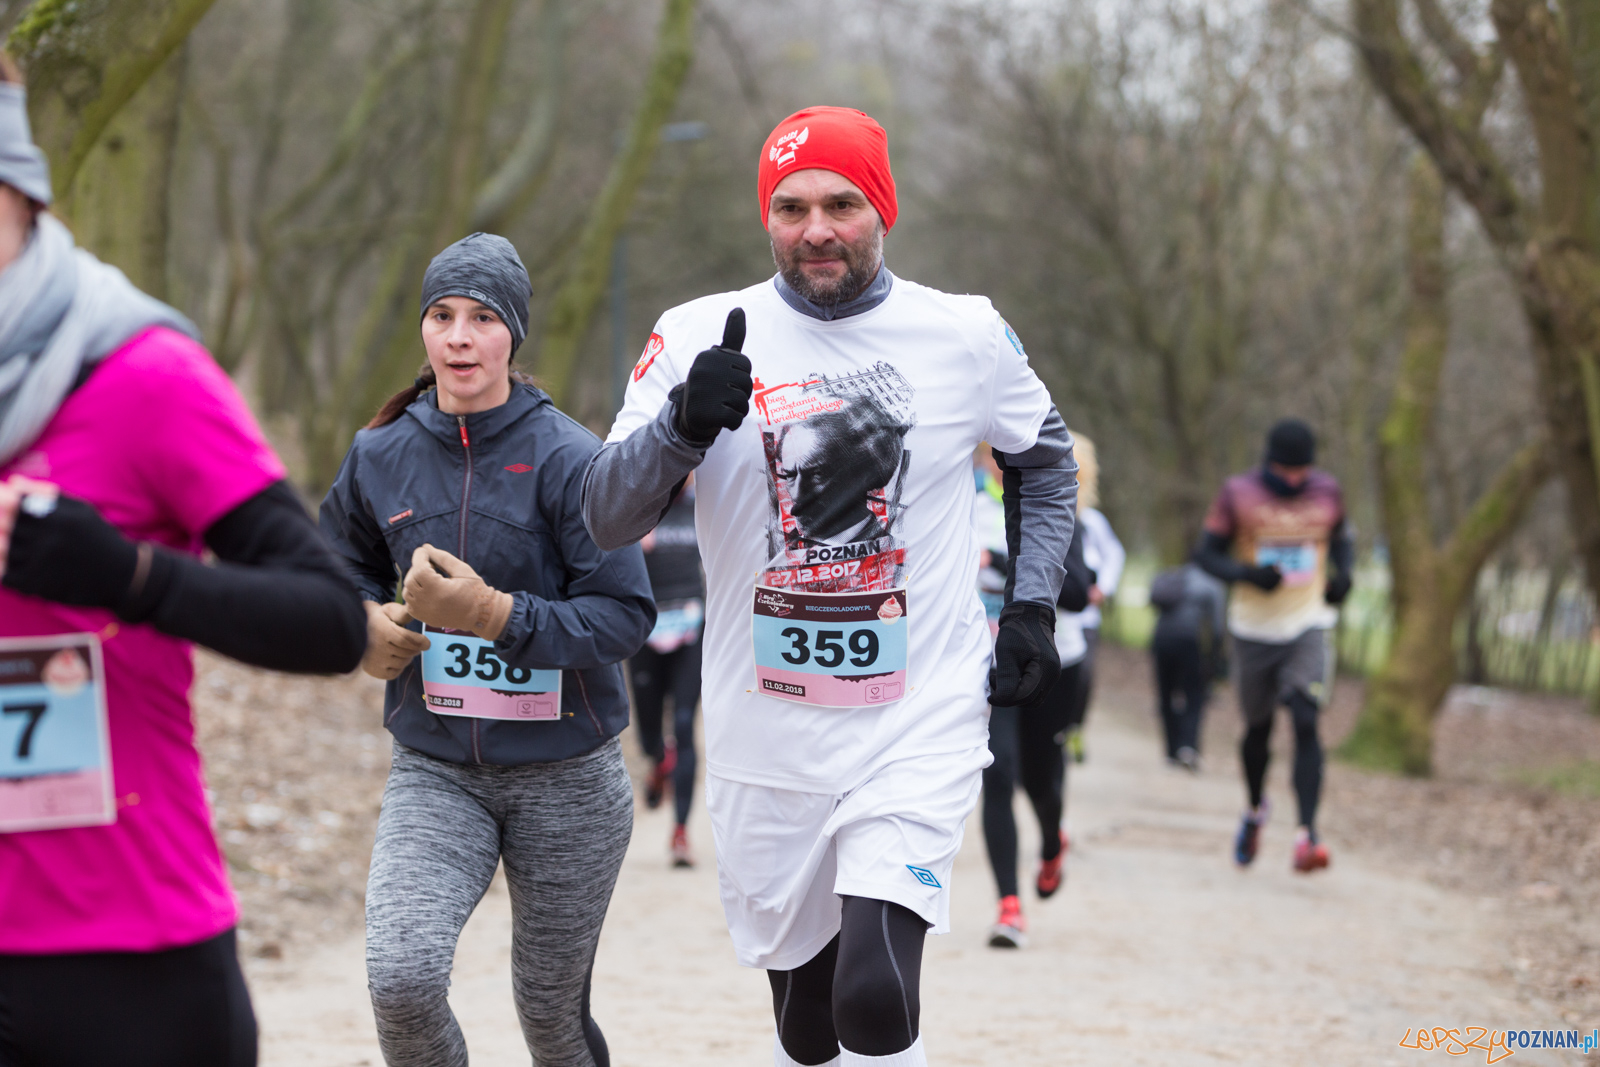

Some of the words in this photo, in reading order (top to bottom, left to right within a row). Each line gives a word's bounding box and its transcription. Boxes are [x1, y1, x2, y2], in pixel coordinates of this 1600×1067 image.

[766, 396, 787, 405] bieg
[770, 396, 816, 417] powstania
[773, 400, 843, 423] wielkopolskiego
[770, 561, 860, 585] 27.12.2017
[781, 627, 879, 667] 359
[764, 681, 803, 695] 11.02.2018
